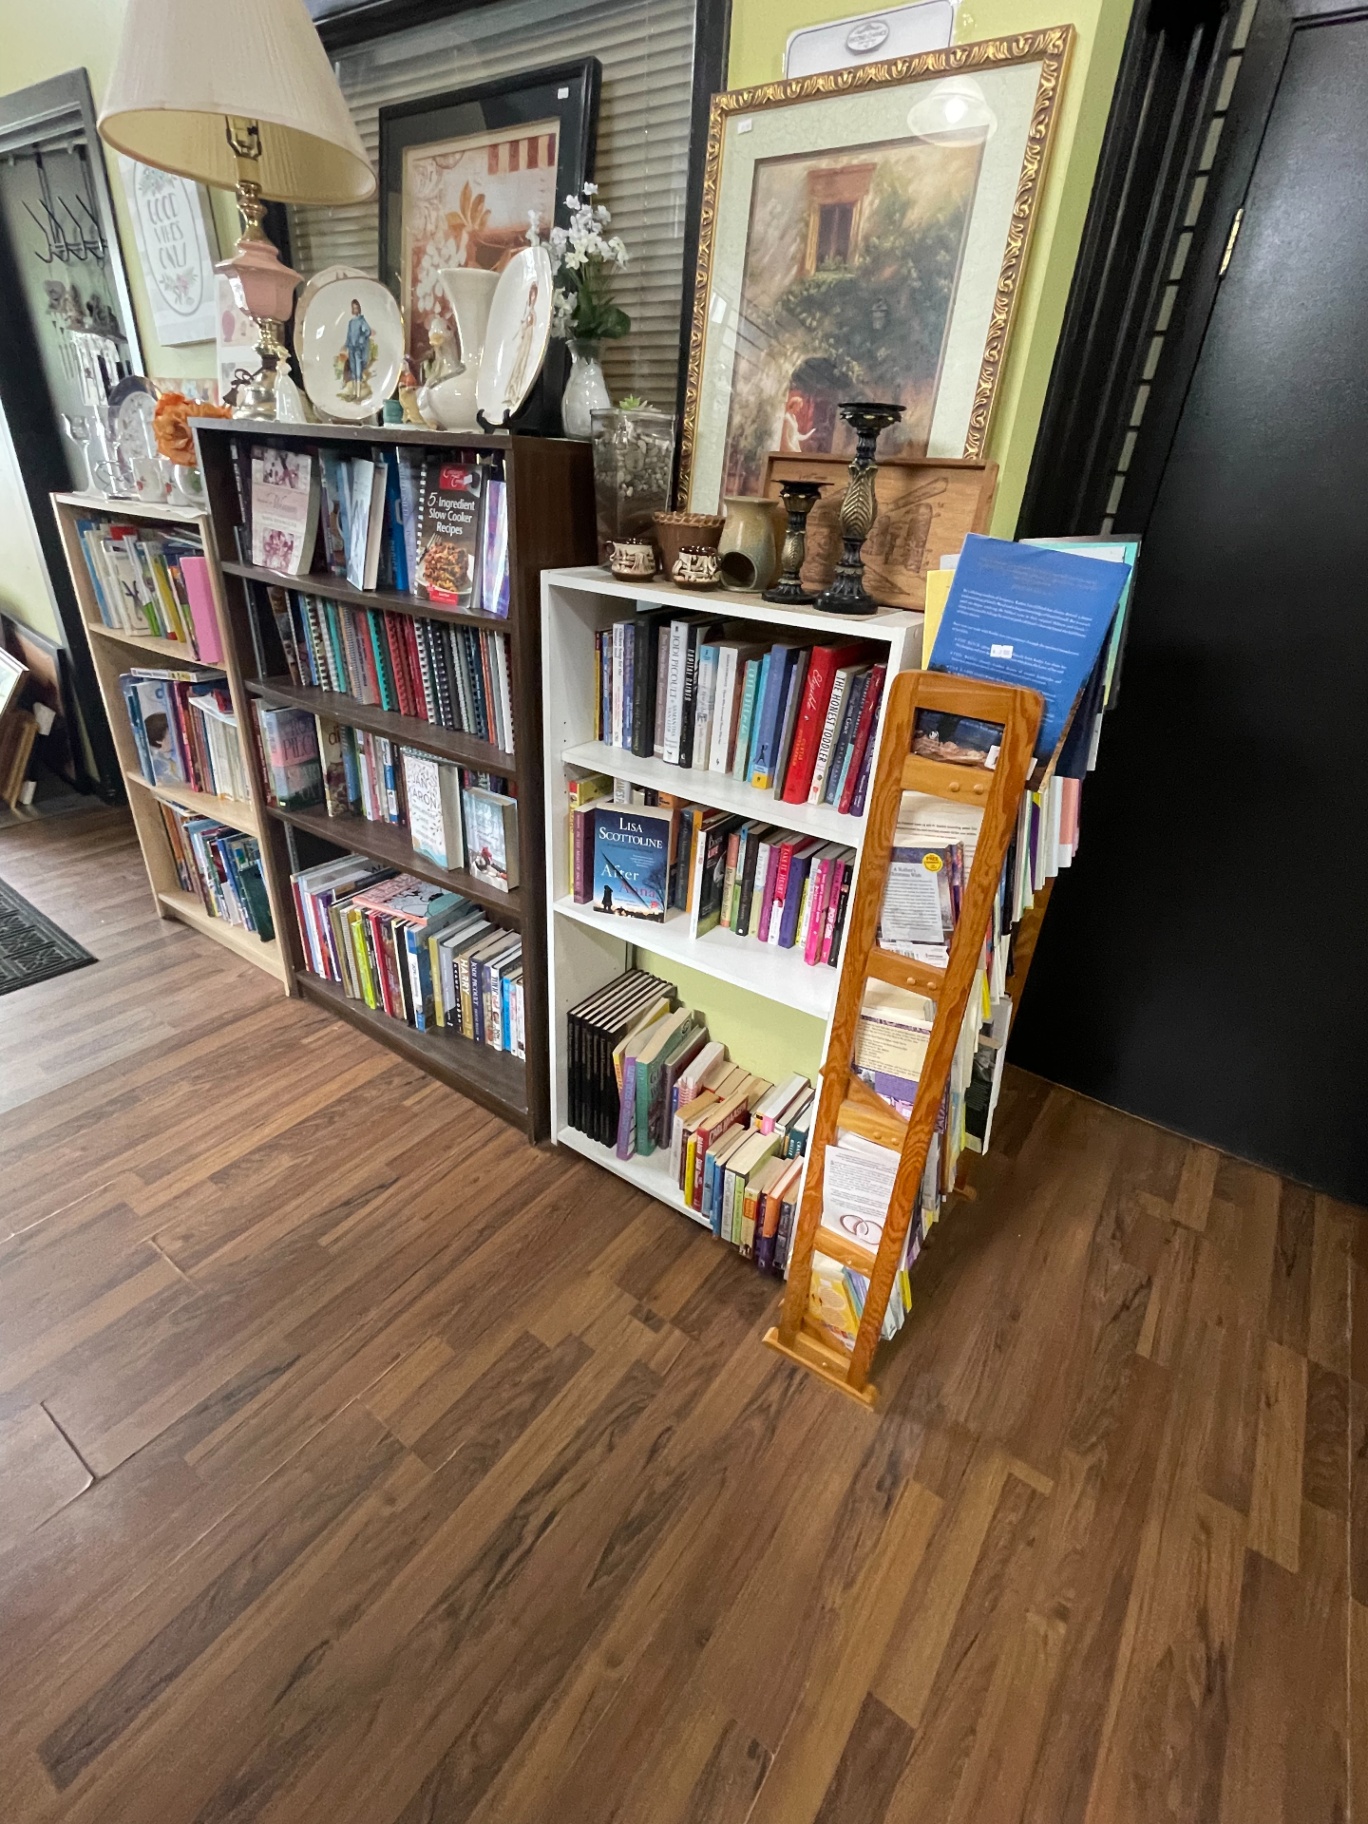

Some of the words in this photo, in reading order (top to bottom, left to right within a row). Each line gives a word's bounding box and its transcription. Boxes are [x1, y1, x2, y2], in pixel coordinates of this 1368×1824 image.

[427, 492, 438, 507] 5
[438, 496, 476, 511] Ingredient
[428, 508, 446, 520] Slow
[447, 510, 472, 524] Cooker
[436, 522, 463, 536] Recipes
[671, 635, 680, 657] JODI
[686, 649, 694, 674] CAPITAL
[669, 659, 679, 697] PICOULT
[836, 676, 845, 692] THE
[806, 668, 823, 710] Eligible
[827, 693, 841, 726] HONEST
[843, 717, 852, 735] Grace
[818, 727, 833, 763] TODDLER
[620, 818, 642, 833] LISA
[599, 826, 663, 849] SCOTTOLINE
[602, 864, 639, 880] After
[778, 873, 786, 894] HEART
[460, 958, 469, 994] HARRY
